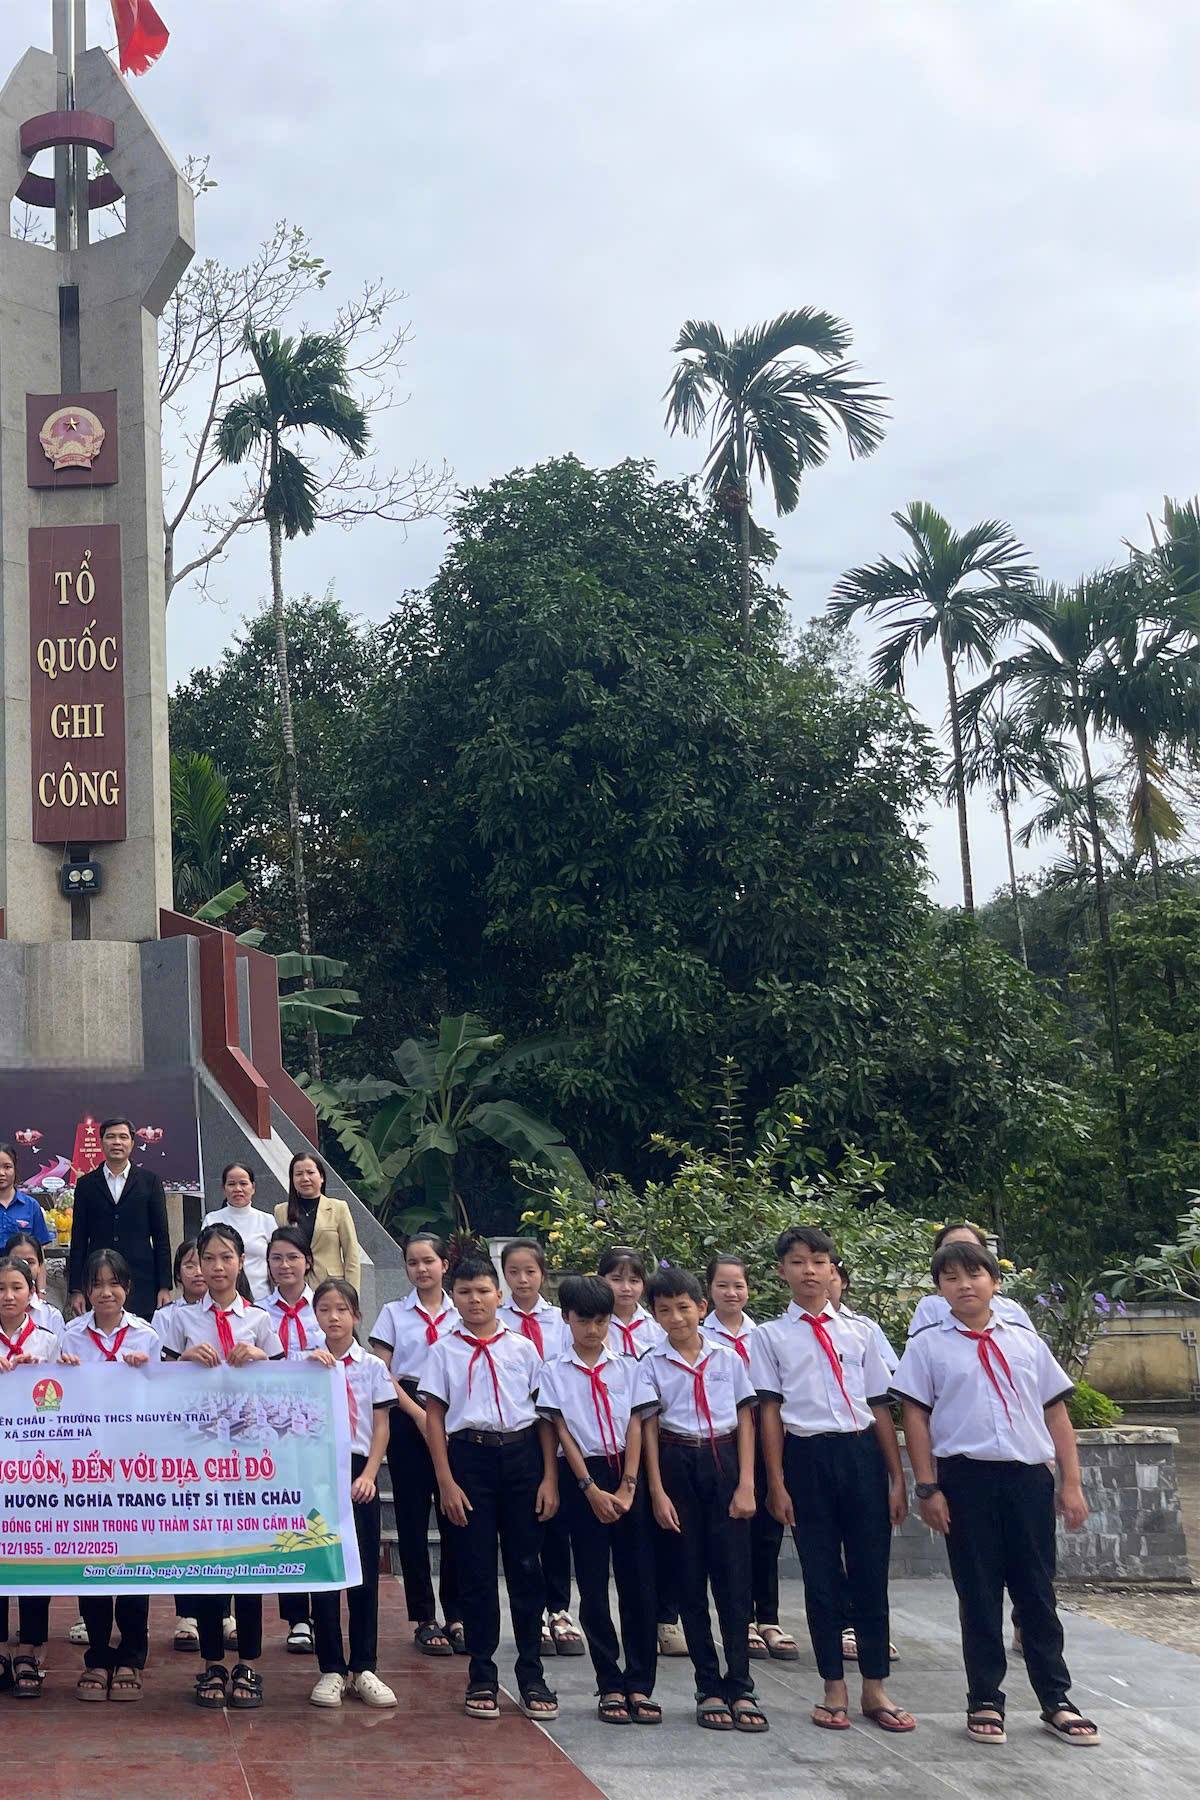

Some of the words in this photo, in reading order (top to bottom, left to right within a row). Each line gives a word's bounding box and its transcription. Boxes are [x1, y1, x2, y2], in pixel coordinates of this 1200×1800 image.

[53, 550, 96, 605] TỔ
[36, 619, 118, 679] QUỐC
[50, 703, 105, 739] GHI
[38, 762, 120, 808] CÔNG
[16, 1415, 46, 1426] CHÂU
[56, 1413, 101, 1424] TRƯỜNG
[104, 1414, 132, 1423] THCS
[136, 1411, 182, 1422] NGUYỄN
[185, 1411, 210, 1422] TRÃI
[4, 1430, 19, 1439] XÃ
[22, 1430, 45, 1439] SƠN
[48, 1426, 74, 1438] CẨM
[78, 1427, 93, 1437] HÀ
[72, 1449, 114, 1482] ĐẾN
[119, 1452, 156, 1481] VỚI
[161, 1458, 200, 1487] ĐỊA
[204, 1449, 241, 1480] CHỈ
[244, 1448, 275, 1480] ĐỎ
[4, 1494, 59, 1508] HƯƠNG
[64, 1491, 113, 1508] NGHĨA
[117, 1493, 167, 1507] TRANG
[172, 1490, 200, 1510] LIỆT
[205, 1490, 218, 1506] SĨ
[224, 1490, 256, 1506] TIÊN
[261, 1488, 301, 1505] CHÂU
[34, 1517, 52, 1532] CHÍ
[56, 1520, 69, 1532] HY
[73, 1519, 99, 1532] SINH
[102, 1519, 138, 1532] TRONG
[141, 1519, 155, 1535] VỤ
[159, 1515, 189, 1532] THẢM
[193, 1516, 213, 1531] SÁT
[216, 1518, 233, 1534] TẠI
[237, 1517, 259, 1531] SƠN
[263, 1512, 287, 1531] CẨM
[291, 1514, 306, 1530] HÀ
[54, 1541, 118, 1555] 02/12/2025)
[84, 1566, 105, 1576] Sơn
[108, 1563, 134, 1576] Cẩm
[136, 1565, 155, 1578] Hà,
[158, 1565, 183, 1578] ngày
[187, 1566, 200, 1575] 28
[202, 1565, 233, 1578] tháng
[235, 1565, 249, 1575] 11
[252, 1565, 276, 1575] năm
[278, 1564, 305, 1575] 2025
